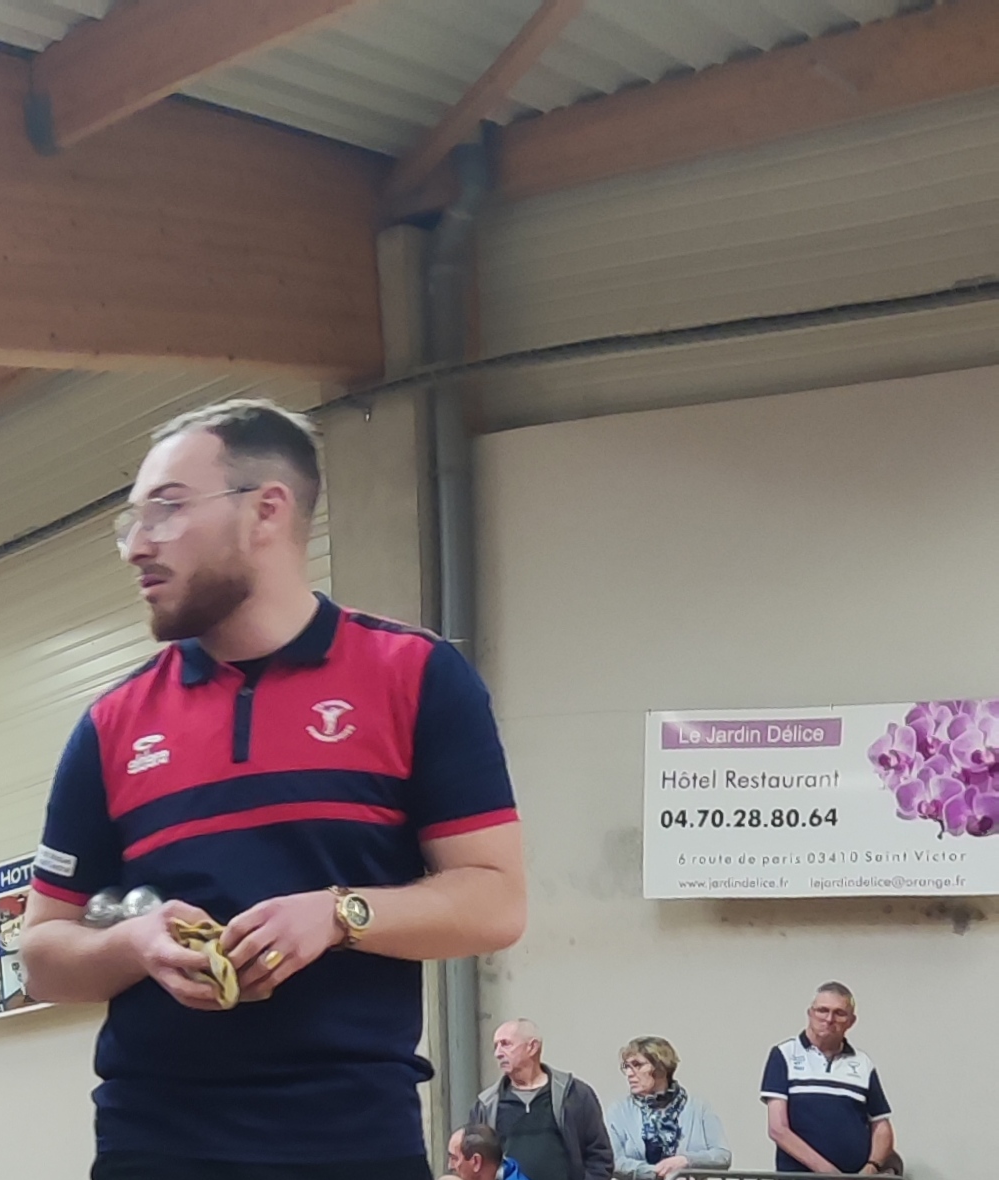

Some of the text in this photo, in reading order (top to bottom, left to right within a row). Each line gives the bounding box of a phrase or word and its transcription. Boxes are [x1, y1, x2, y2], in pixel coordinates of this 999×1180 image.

[679, 724, 825, 744] Le Jardin Délice
[661, 769, 840, 789] Hôtel Restaurant
[660, 807, 839, 829] 04.70.28.80.64
[678, 850, 968, 867] 6 route de paris 03410 Saint Victor
